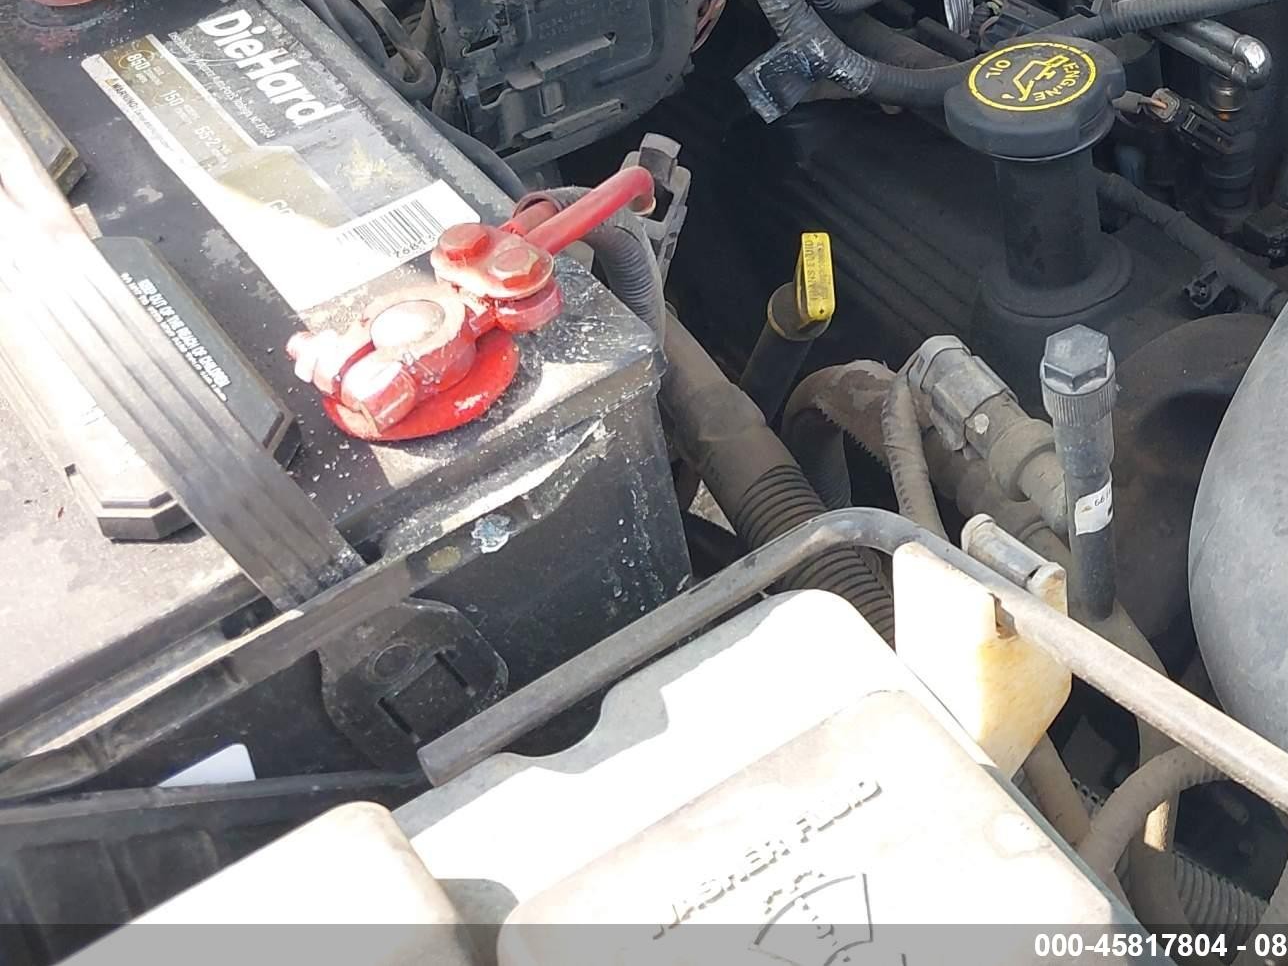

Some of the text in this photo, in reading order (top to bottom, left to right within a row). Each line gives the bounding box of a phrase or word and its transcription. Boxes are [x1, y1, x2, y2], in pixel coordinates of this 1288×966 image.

[127, 52, 151, 72] 850
[198, 8, 345, 131] DieHard
[986, 58, 1012, 79] OIL
[1032, 62, 1081, 102] ENGINE
[159, 89, 185, 107] 150
